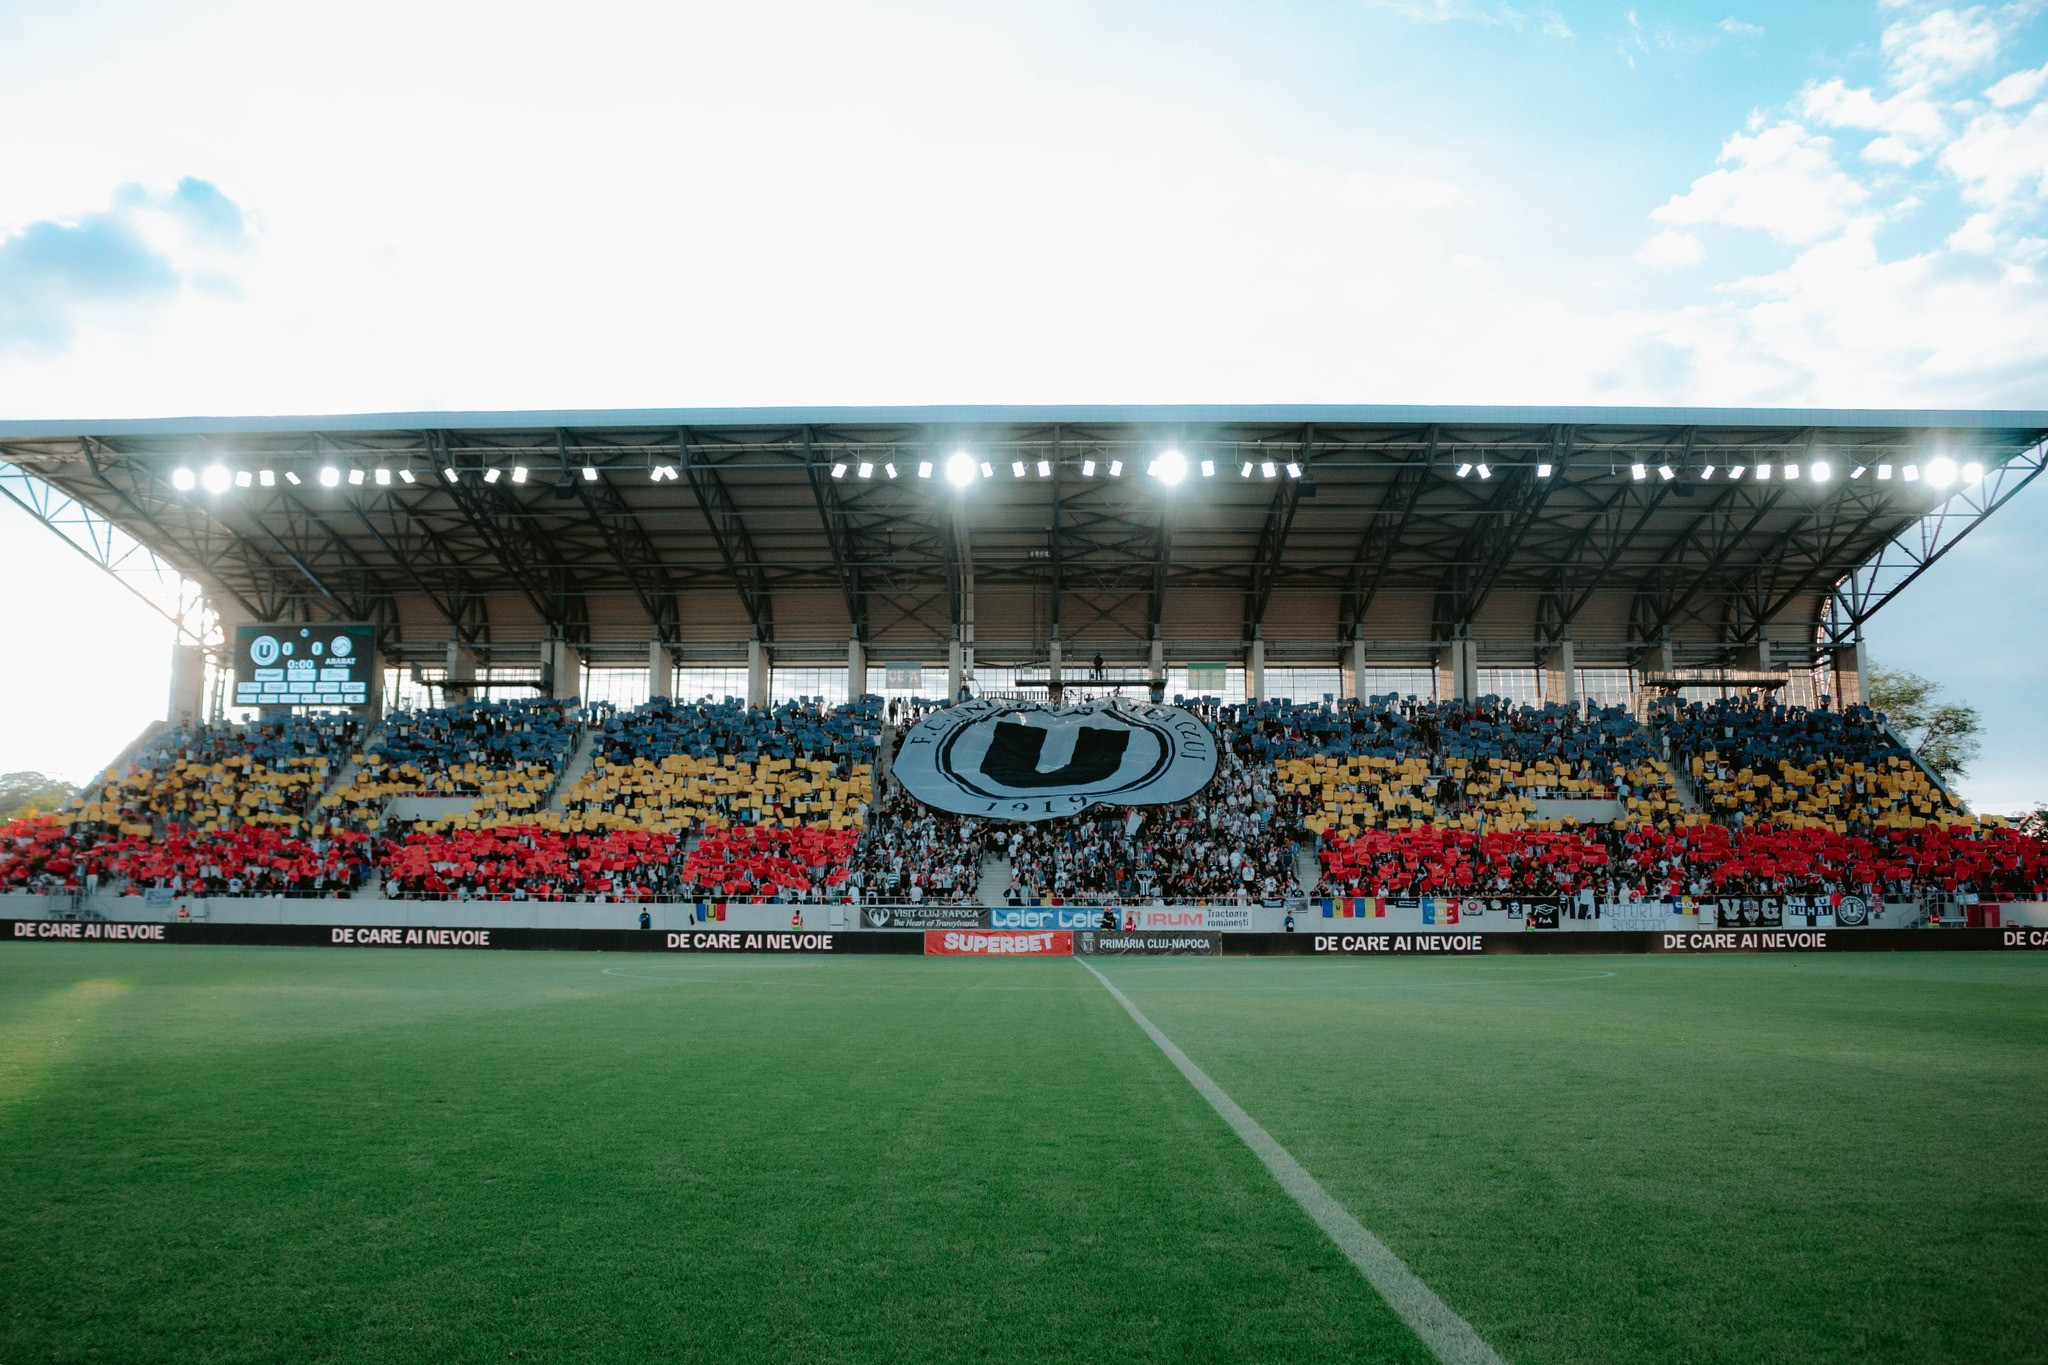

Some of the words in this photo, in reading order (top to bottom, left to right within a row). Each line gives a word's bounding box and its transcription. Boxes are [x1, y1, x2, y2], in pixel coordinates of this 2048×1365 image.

[259, 645, 270, 658] U
[282, 642, 294, 656] 0
[311, 642, 324, 656] 0
[287, 660, 314, 669] 0:00
[1175, 722, 1206, 761] CLUJ
[979, 721, 1131, 788] U
[983, 796, 1087, 813] 1919
[706, 904, 716, 918] U
[894, 909, 918, 918] VISIT
[919, 909, 979, 919] CLUJ-NAPOCA
[1207, 909, 1248, 918] Tractoare
[1720, 898, 1741, 920] V
[1761, 898, 1780, 920] G
[1789, 906, 1829, 915] NUMAI
[893, 919, 904, 927] The
[905, 919, 926, 928] Heart
[926, 919, 935, 928] of
[935, 919, 979, 928] Transylvania
[993, 910, 1053, 927] Leier
[1058, 911, 1120, 928] Leie
[1147, 913, 1203, 926] IRUM
[14, 922, 35, 937] DE
[38, 923, 82, 938] CARE
[84, 924, 101, 938] AI
[104, 924, 165, 939] NEVOIE
[331, 928, 355, 943] DE
[356, 929, 403, 944] CARE
[405, 930, 423, 944] AI
[426, 930, 490, 945] NEVOIE
[667, 933, 691, 948] DE
[693, 934, 741, 948] CARE
[745, 934, 763, 948] AI
[766, 935, 833, 949] NEVOIE
[943, 932, 1055, 953] SUPERBET
[1099, 937, 1145, 949] PRIMĂRIA
[1147, 938, 1210, 949] CLUJ-NAPOCA
[1314, 936, 1339, 950] DE
[1341, 936, 1390, 950] CARE
[1393, 936, 1412, 950] AI
[1416, 936, 1482, 950] NEVOIE
[1663, 934, 1687, 948] DE
[1689, 934, 1737, 948] CARE
[1740, 934, 1758, 948] AI
[1762, 933, 1827, 947] NEVOIE
[2004, 931, 2027, 945] DE
